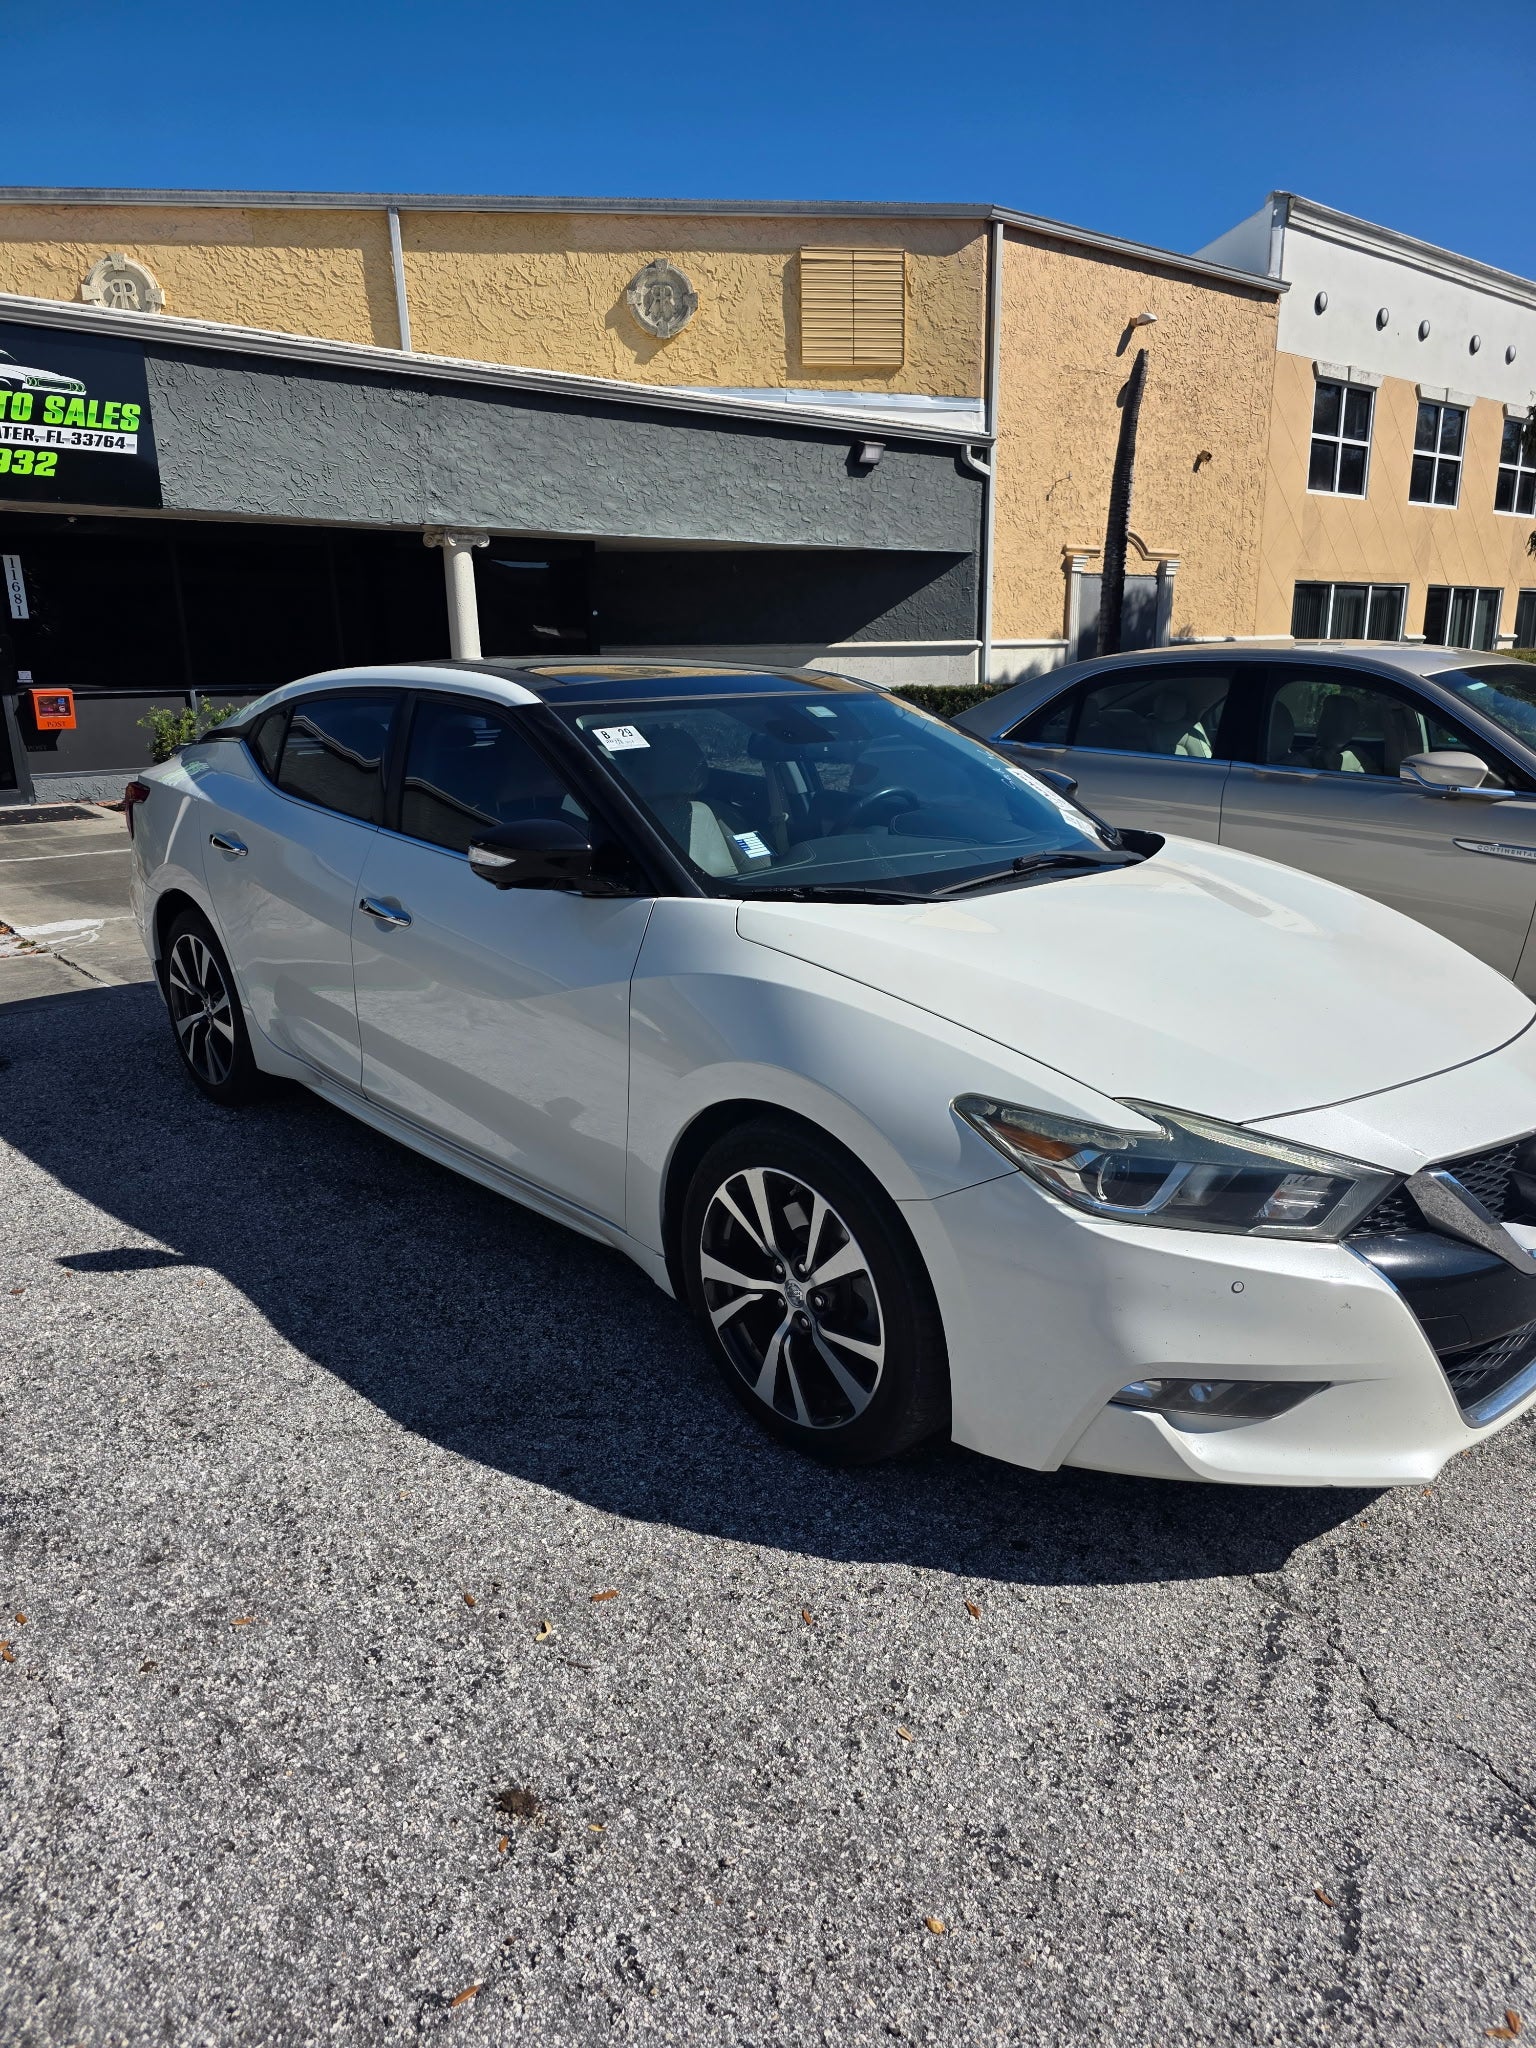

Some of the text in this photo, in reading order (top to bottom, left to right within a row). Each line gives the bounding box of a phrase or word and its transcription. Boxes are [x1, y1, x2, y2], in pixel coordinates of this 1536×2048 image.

[43, 395, 141, 432] SALES
[46, 430, 65, 444] FL
[71, 432, 126, 449] 33764
[9, 557, 23, 617] 11681
[617, 728, 633, 738] 29
